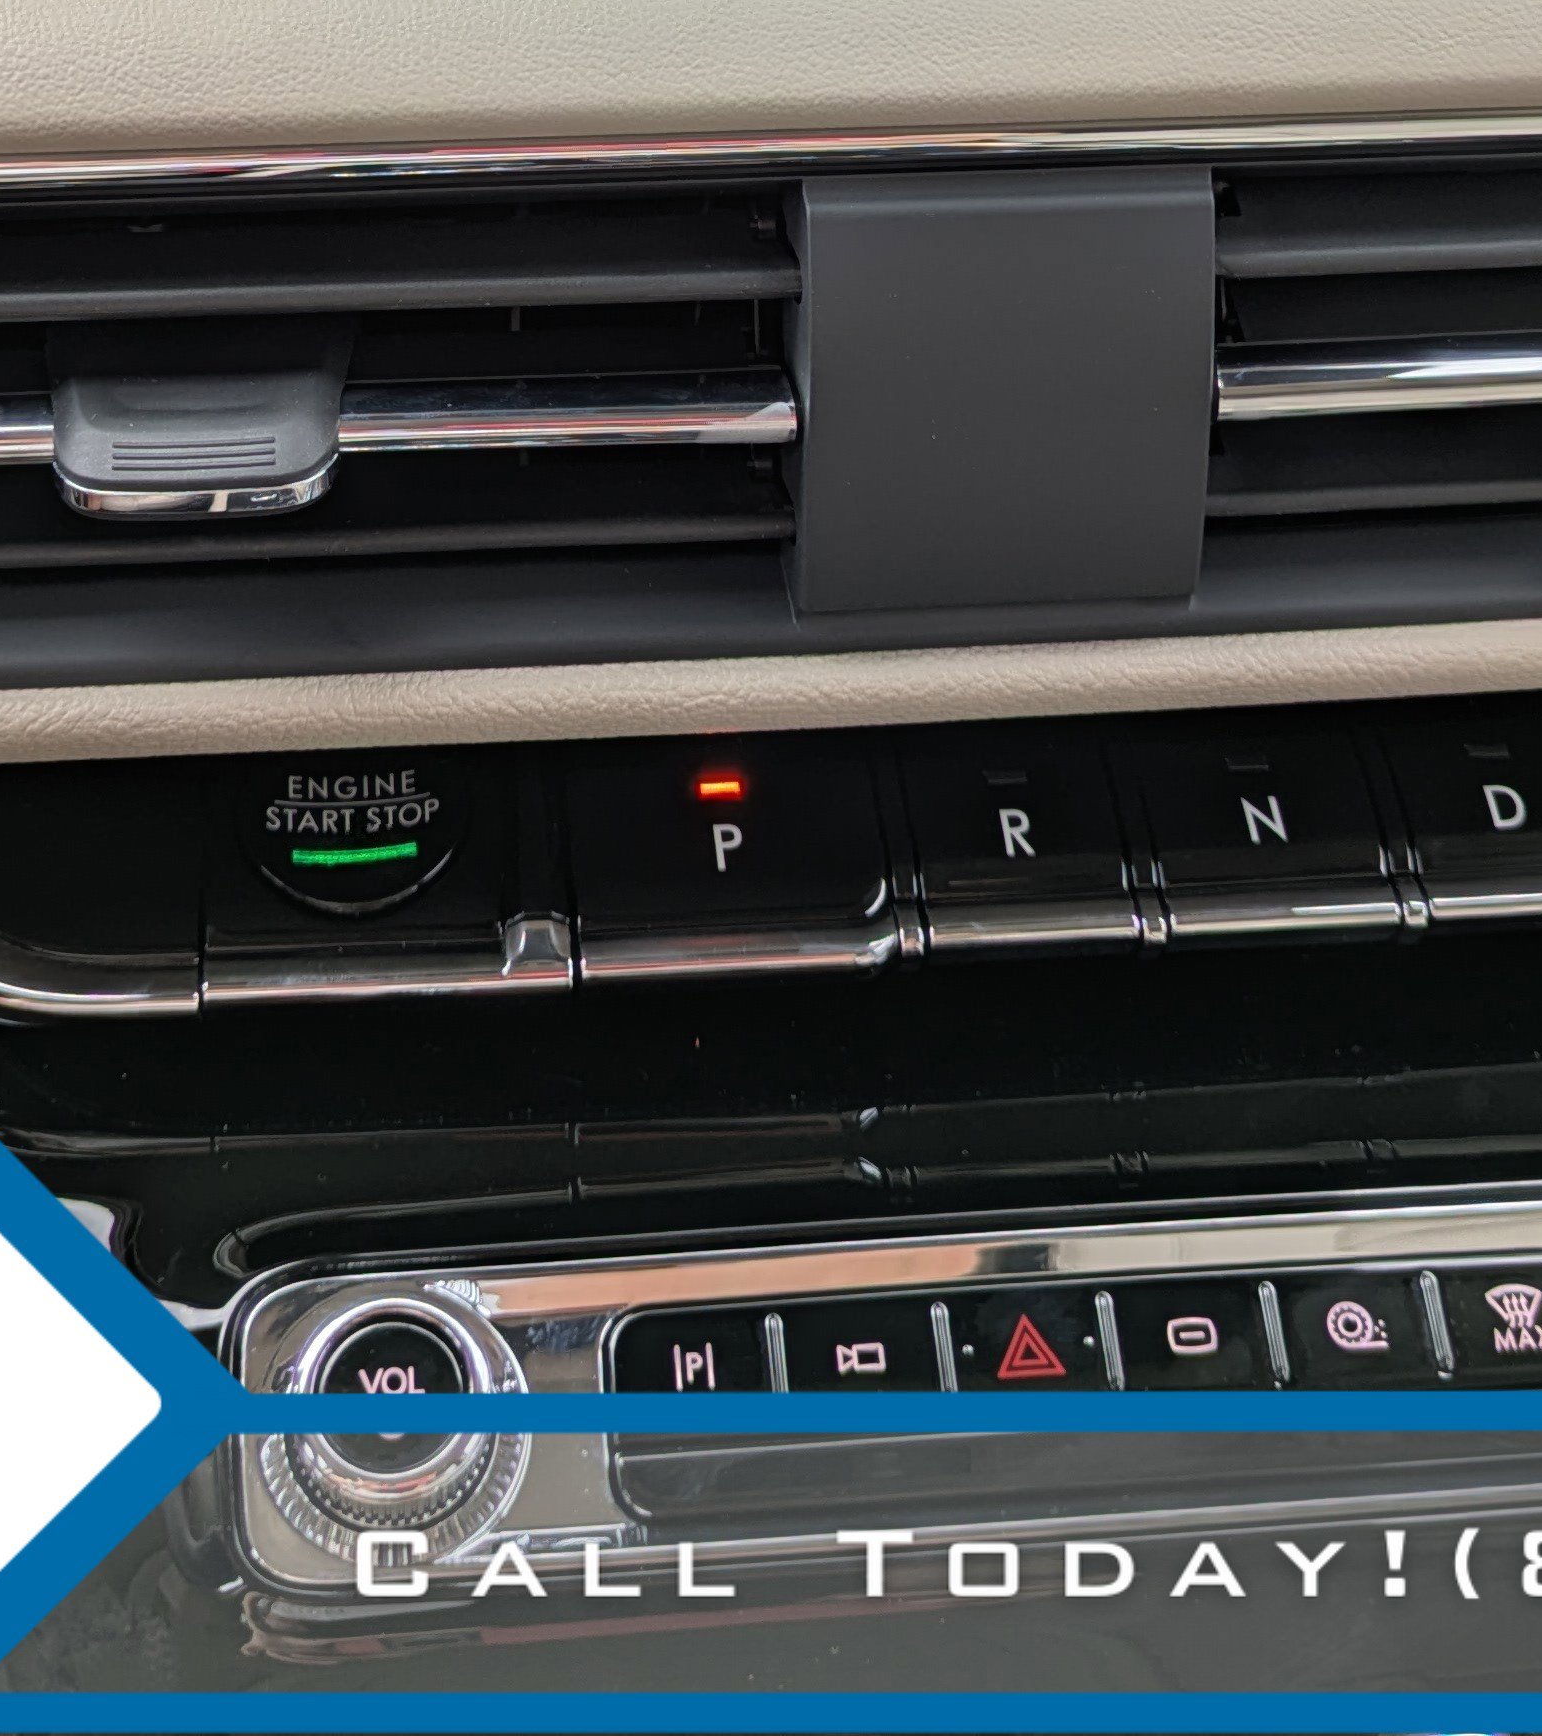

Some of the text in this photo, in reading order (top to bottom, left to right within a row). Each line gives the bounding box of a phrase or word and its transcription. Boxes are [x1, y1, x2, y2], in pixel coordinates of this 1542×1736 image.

[286, 771, 417, 803] ENGINE
[1481, 783, 1527, 830] D
[263, 795, 442, 835] START STOP
[998, 807, 1036, 858] R
[1240, 794, 1288, 844] N
[711, 822, 744, 872] P
[357, 1365, 426, 1394] VOL
